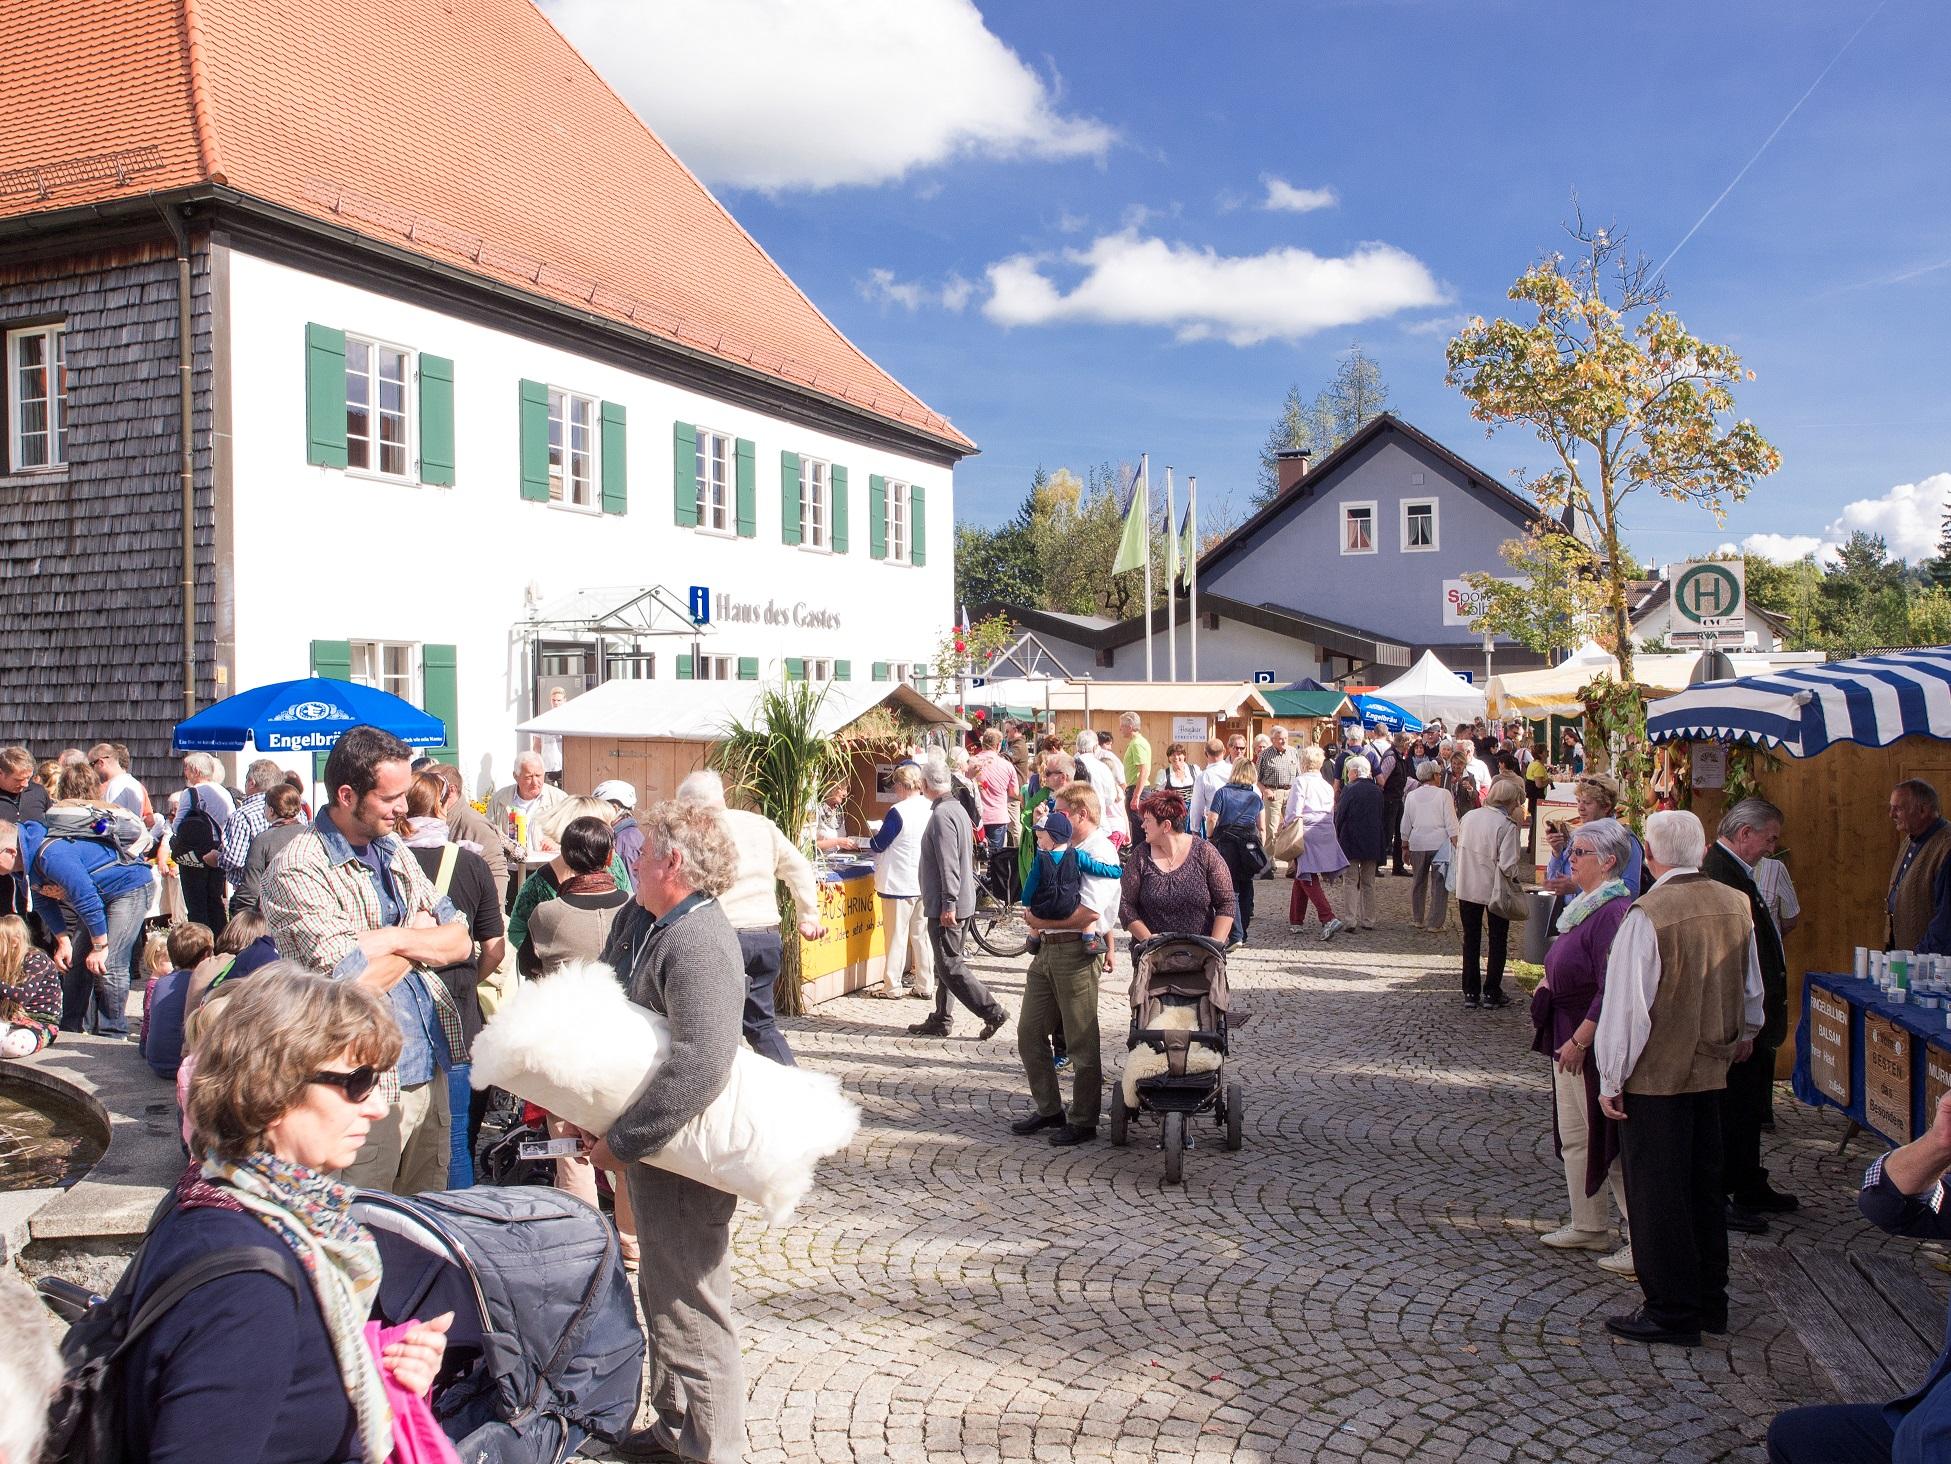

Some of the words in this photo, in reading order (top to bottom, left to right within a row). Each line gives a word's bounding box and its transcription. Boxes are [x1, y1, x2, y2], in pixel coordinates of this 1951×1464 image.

[1694, 577, 1720, 611] H
[716, 592, 760, 624] Haus
[764, 598, 789, 626] des
[793, 601, 841, 630] Gastes
[1260, 673, 1270, 684] P
[1365, 711, 1398, 724] Engelbräu
[269, 730, 341, 751] Engelbrä
[176, 857, 205, 868] adidas
[1818, 1024, 1841, 1046] BALSAM
[1872, 1052, 1903, 1079] BESTEN
